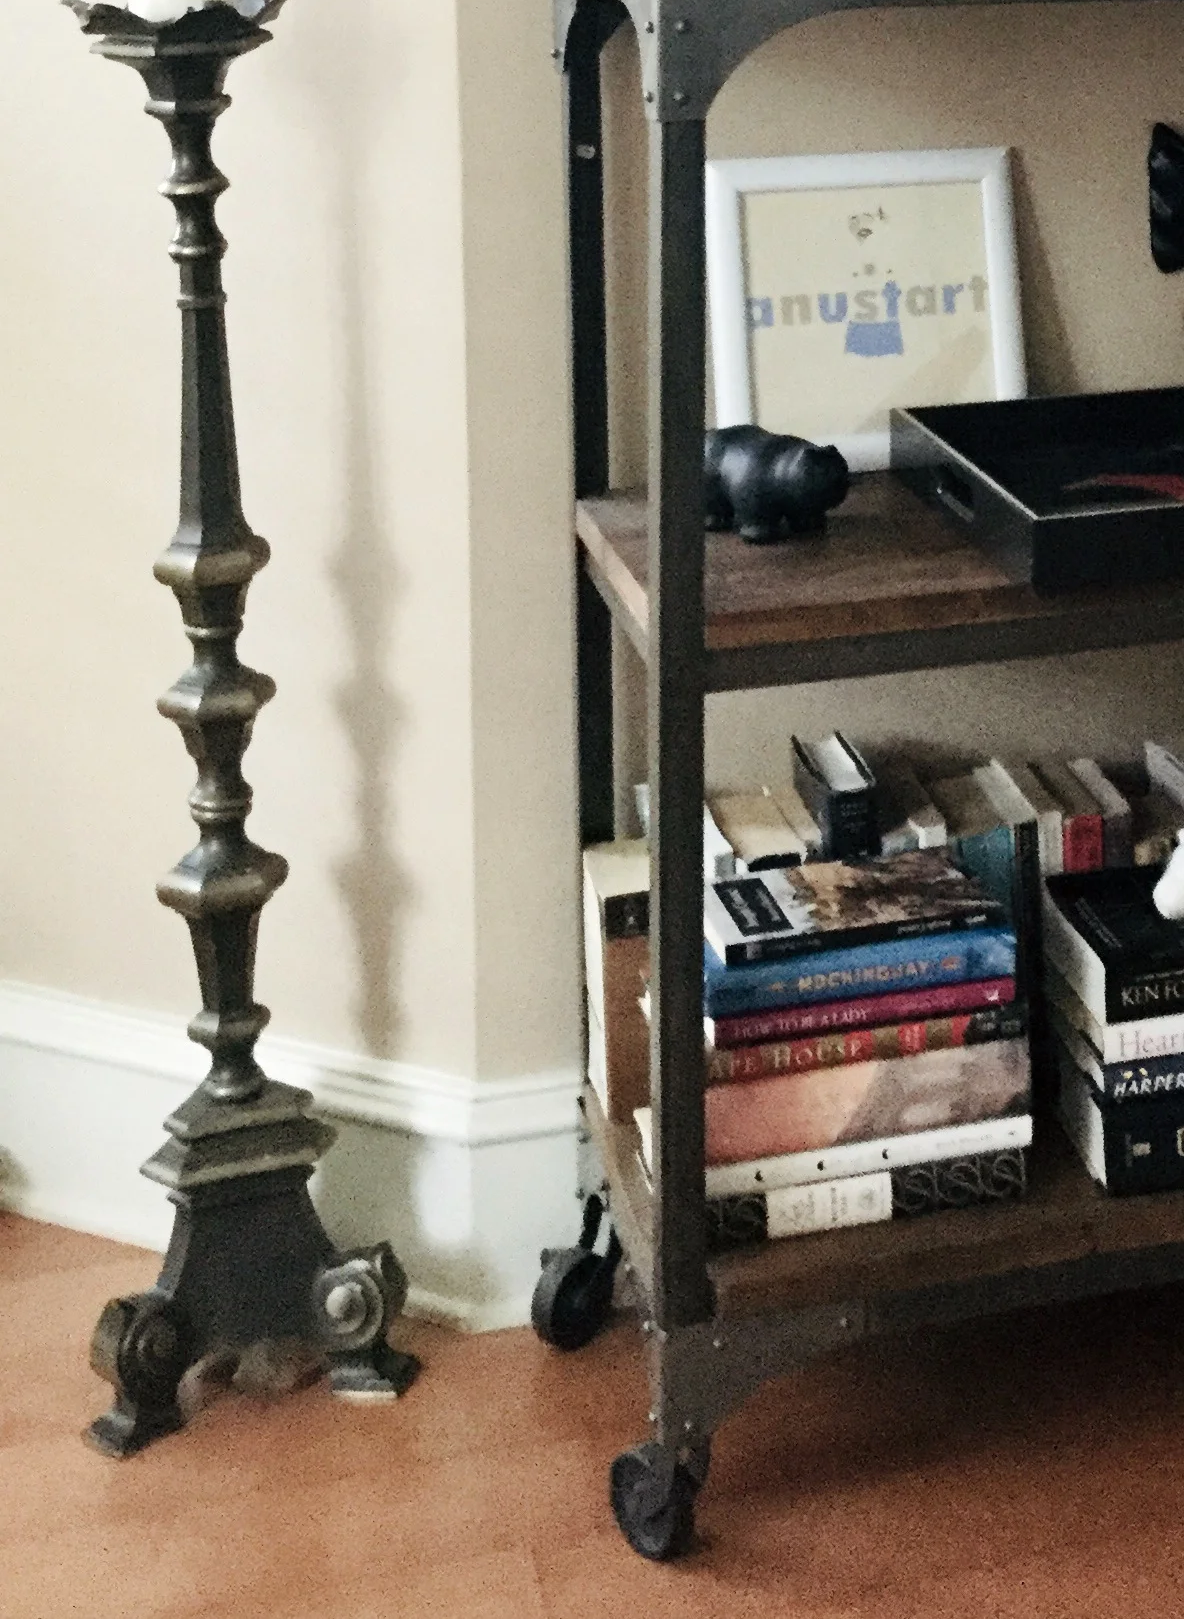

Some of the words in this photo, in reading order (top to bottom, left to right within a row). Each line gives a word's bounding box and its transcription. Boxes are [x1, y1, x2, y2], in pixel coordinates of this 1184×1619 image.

[748, 274, 989, 331] anustart
[798, 958, 930, 993] MOCKINGJAY
[1120, 985, 1159, 1007] KEN
